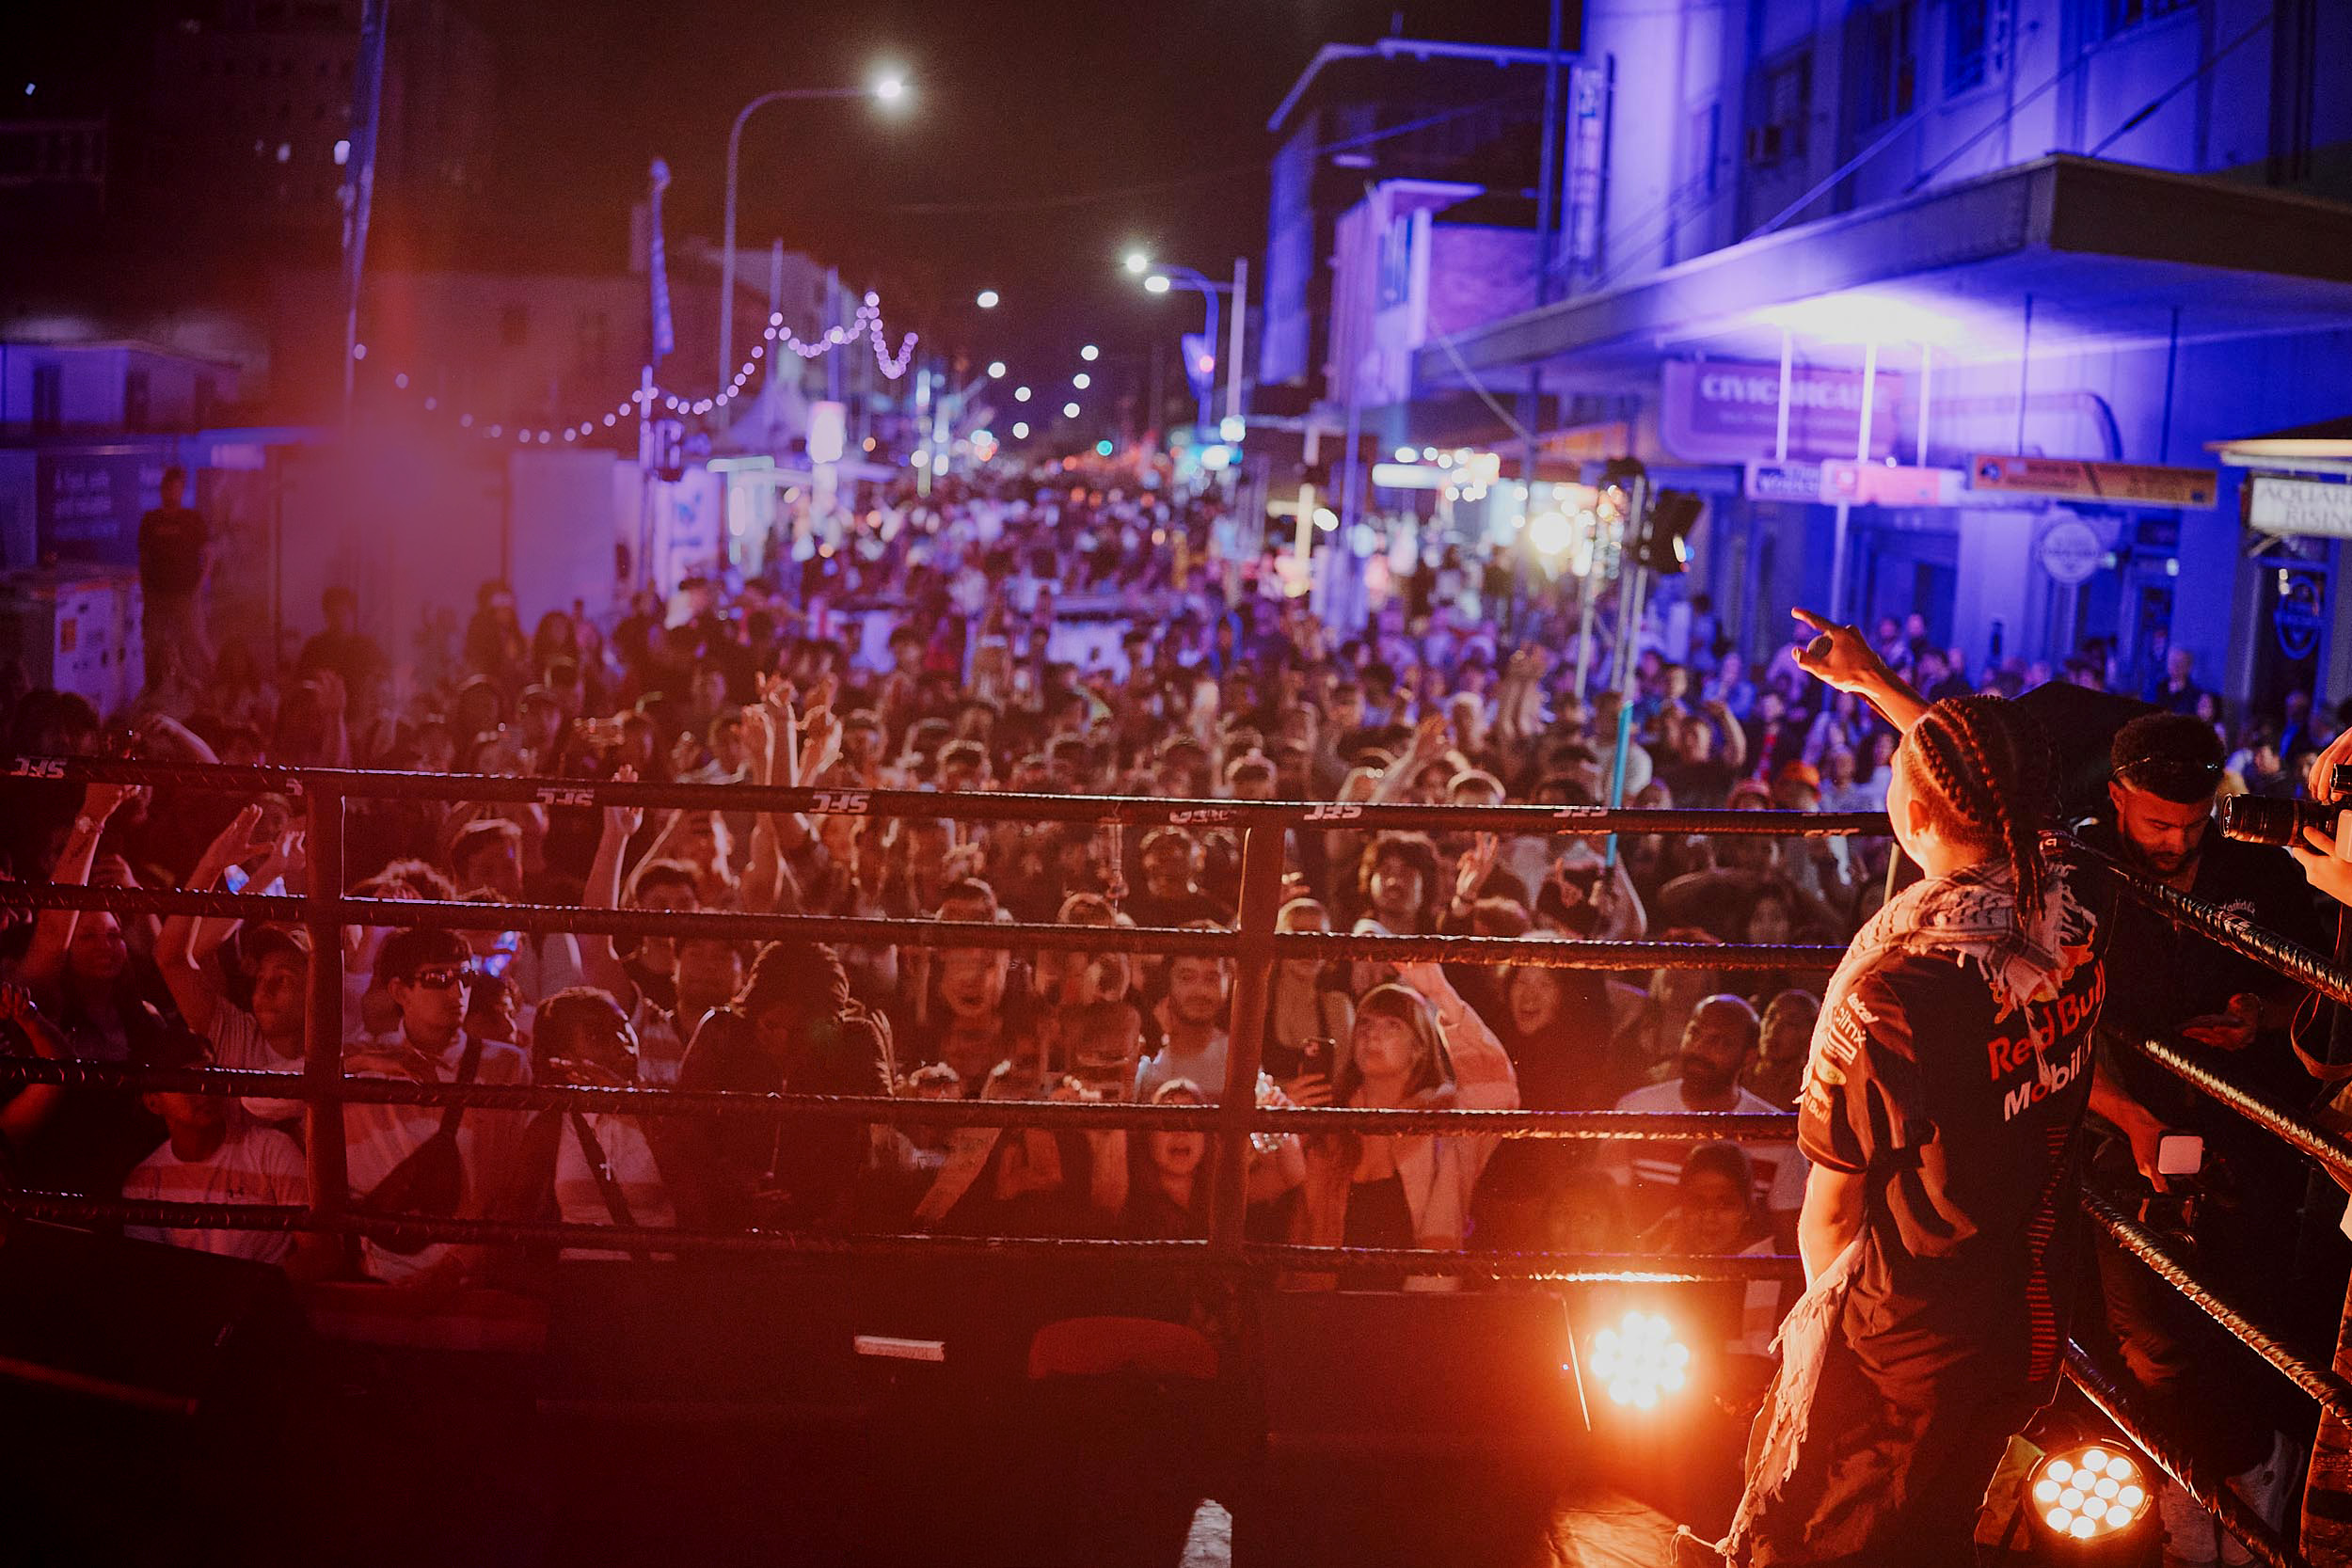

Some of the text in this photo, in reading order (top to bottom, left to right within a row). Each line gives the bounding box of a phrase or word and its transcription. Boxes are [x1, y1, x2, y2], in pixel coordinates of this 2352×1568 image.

[2260, 479, 2352, 505] AQUAR
[2286, 505, 2352, 528] RISIN
[809, 791, 870, 814] SFC
[1987, 959, 2106, 1081] Red Bull
[2004, 1045, 2082, 1122] Mobil
